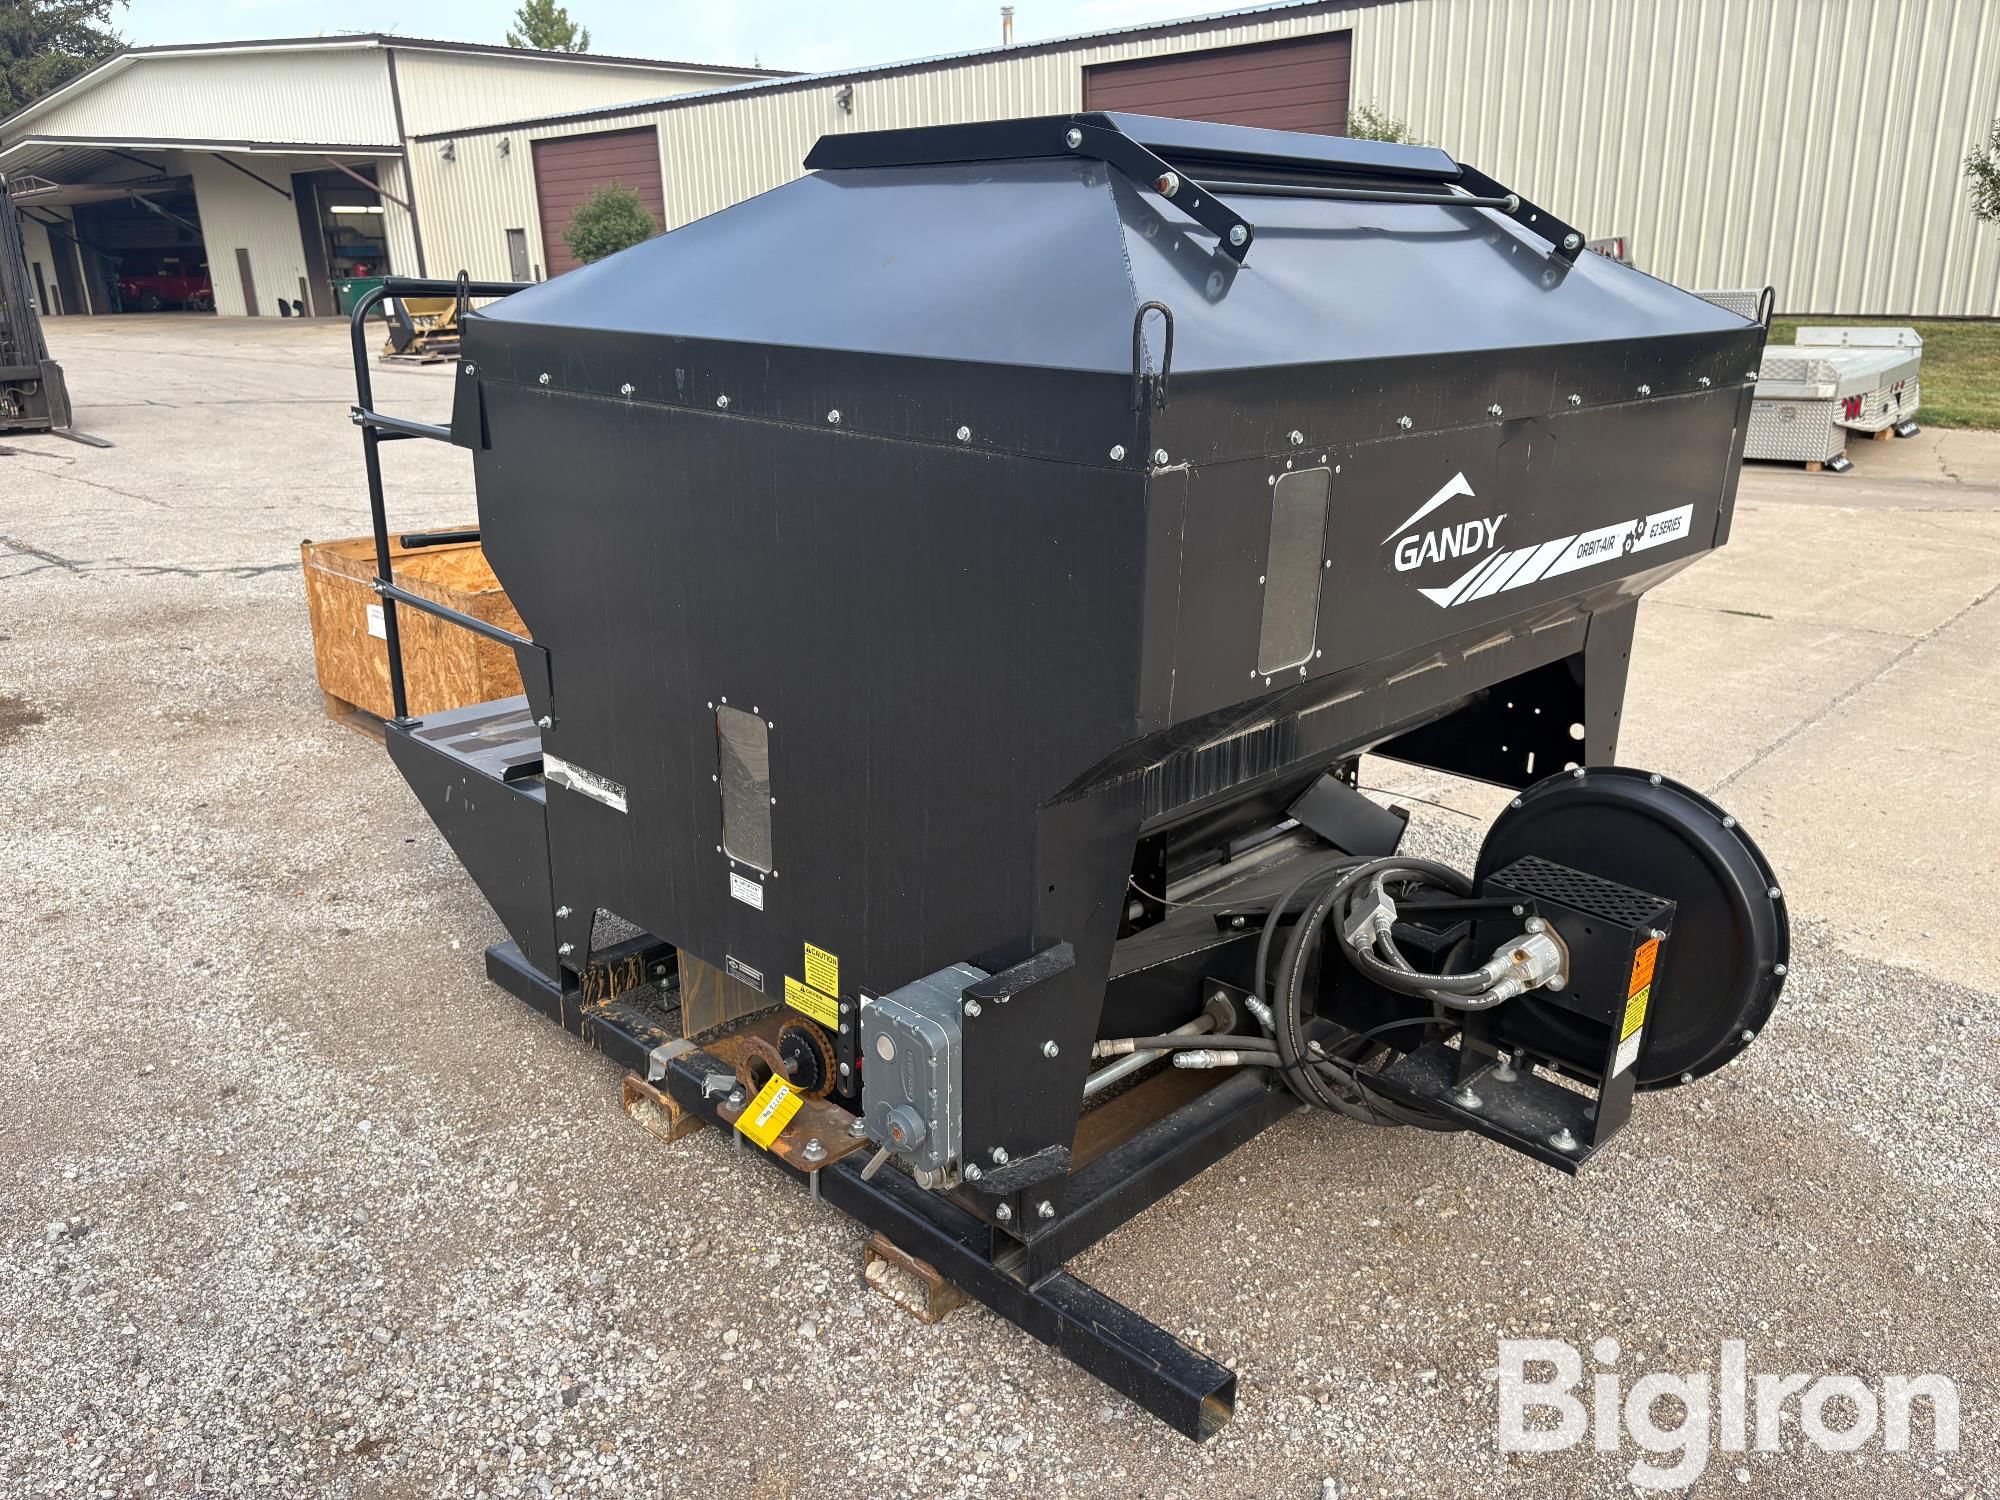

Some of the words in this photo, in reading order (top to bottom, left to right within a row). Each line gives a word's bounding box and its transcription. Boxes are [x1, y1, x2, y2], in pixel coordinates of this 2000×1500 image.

[1658, 516, 1682, 535] SERIES
[1394, 513, 1504, 571] GANDY
[1576, 535, 1616, 559] ORBIT-AIR
[811, 948, 837, 966] CAUTION
